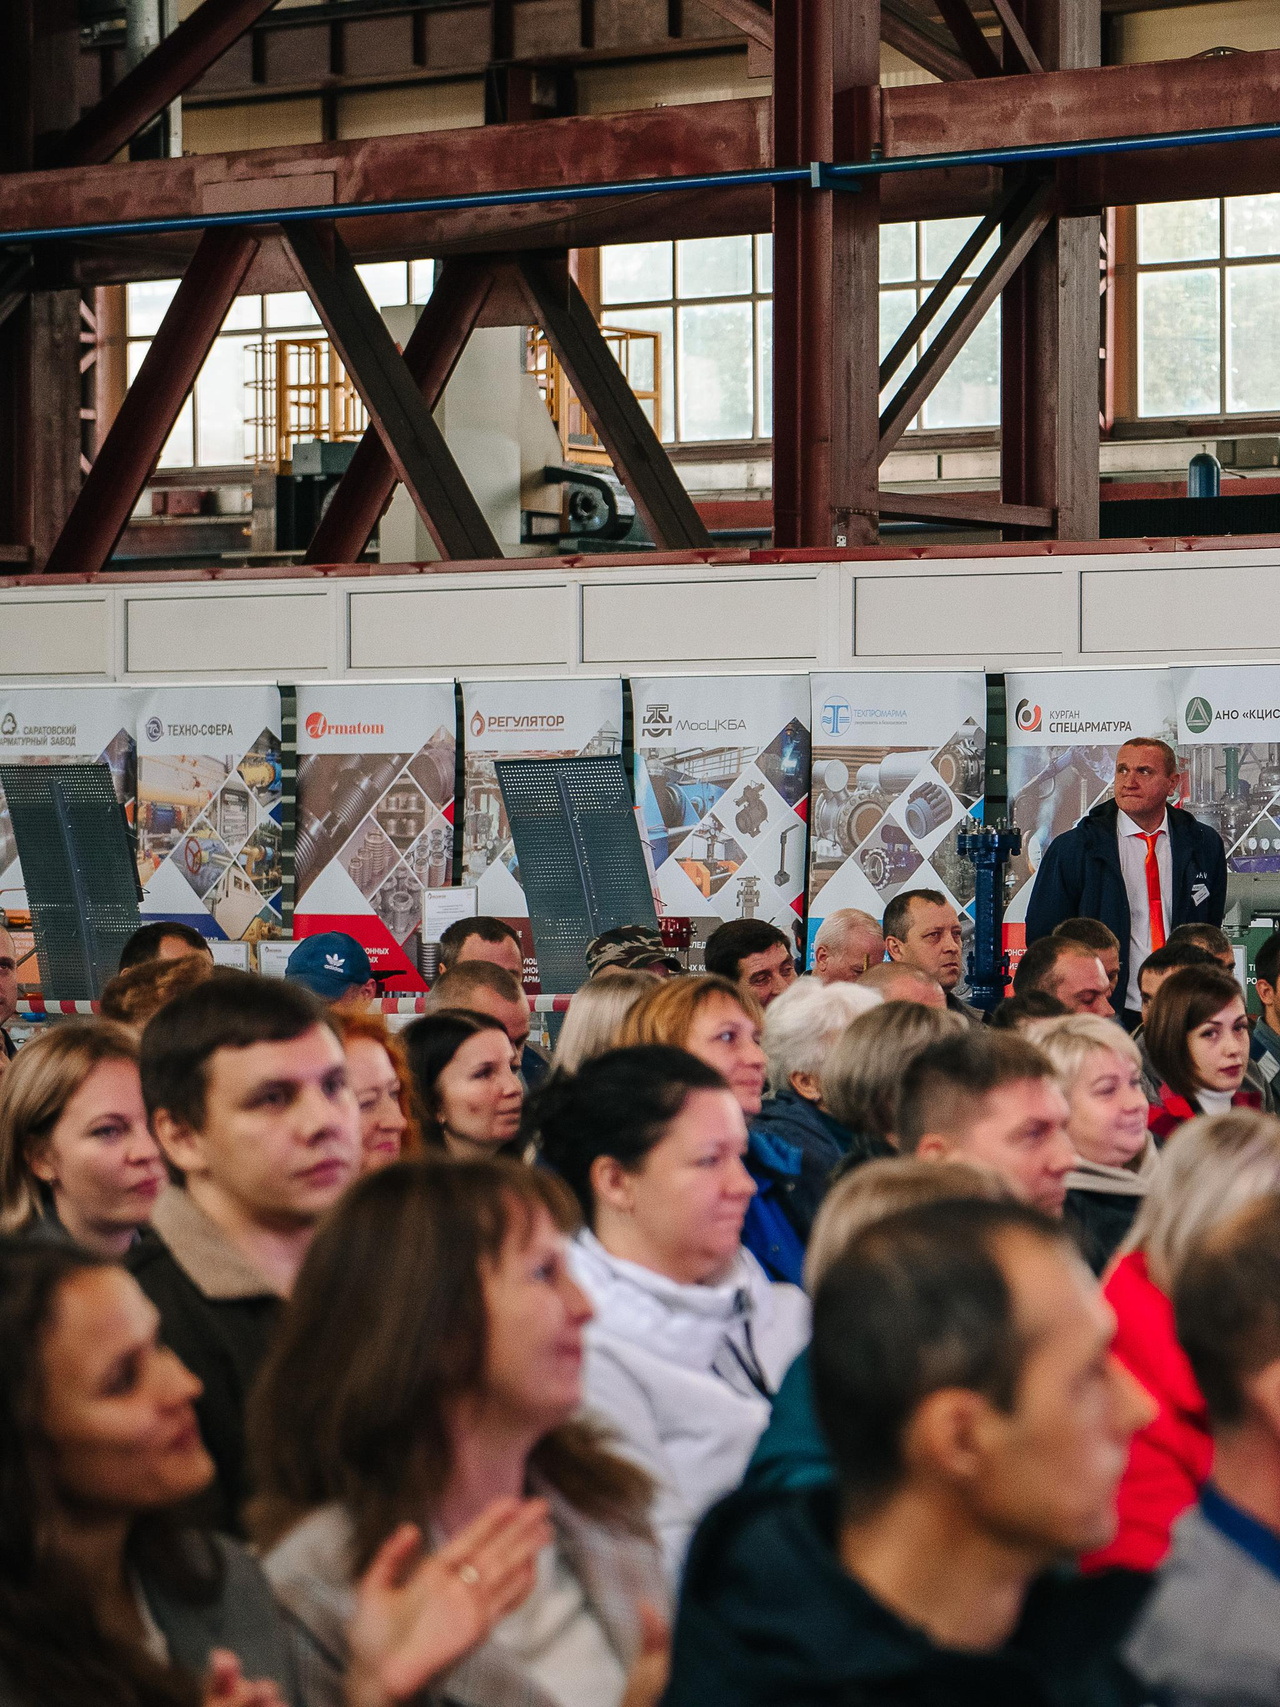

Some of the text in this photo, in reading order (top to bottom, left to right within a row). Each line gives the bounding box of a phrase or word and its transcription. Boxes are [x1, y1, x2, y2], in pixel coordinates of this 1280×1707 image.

[1049, 710, 1081, 720] КУРГАН
[1215, 709, 1240, 720] АНО
[488, 715, 565, 727] РЕГУЛЯТОР
[675, 719, 747, 733] МосЦКБА
[23, 724, 77, 735] САРАТОВСКИЙ
[168, 723, 233, 736] ТЕХНО-СФЕРА
[1049, 721, 1132, 734] СПЕЦАРМАТУРА
[50, 736, 76, 746] ЗАВОД
